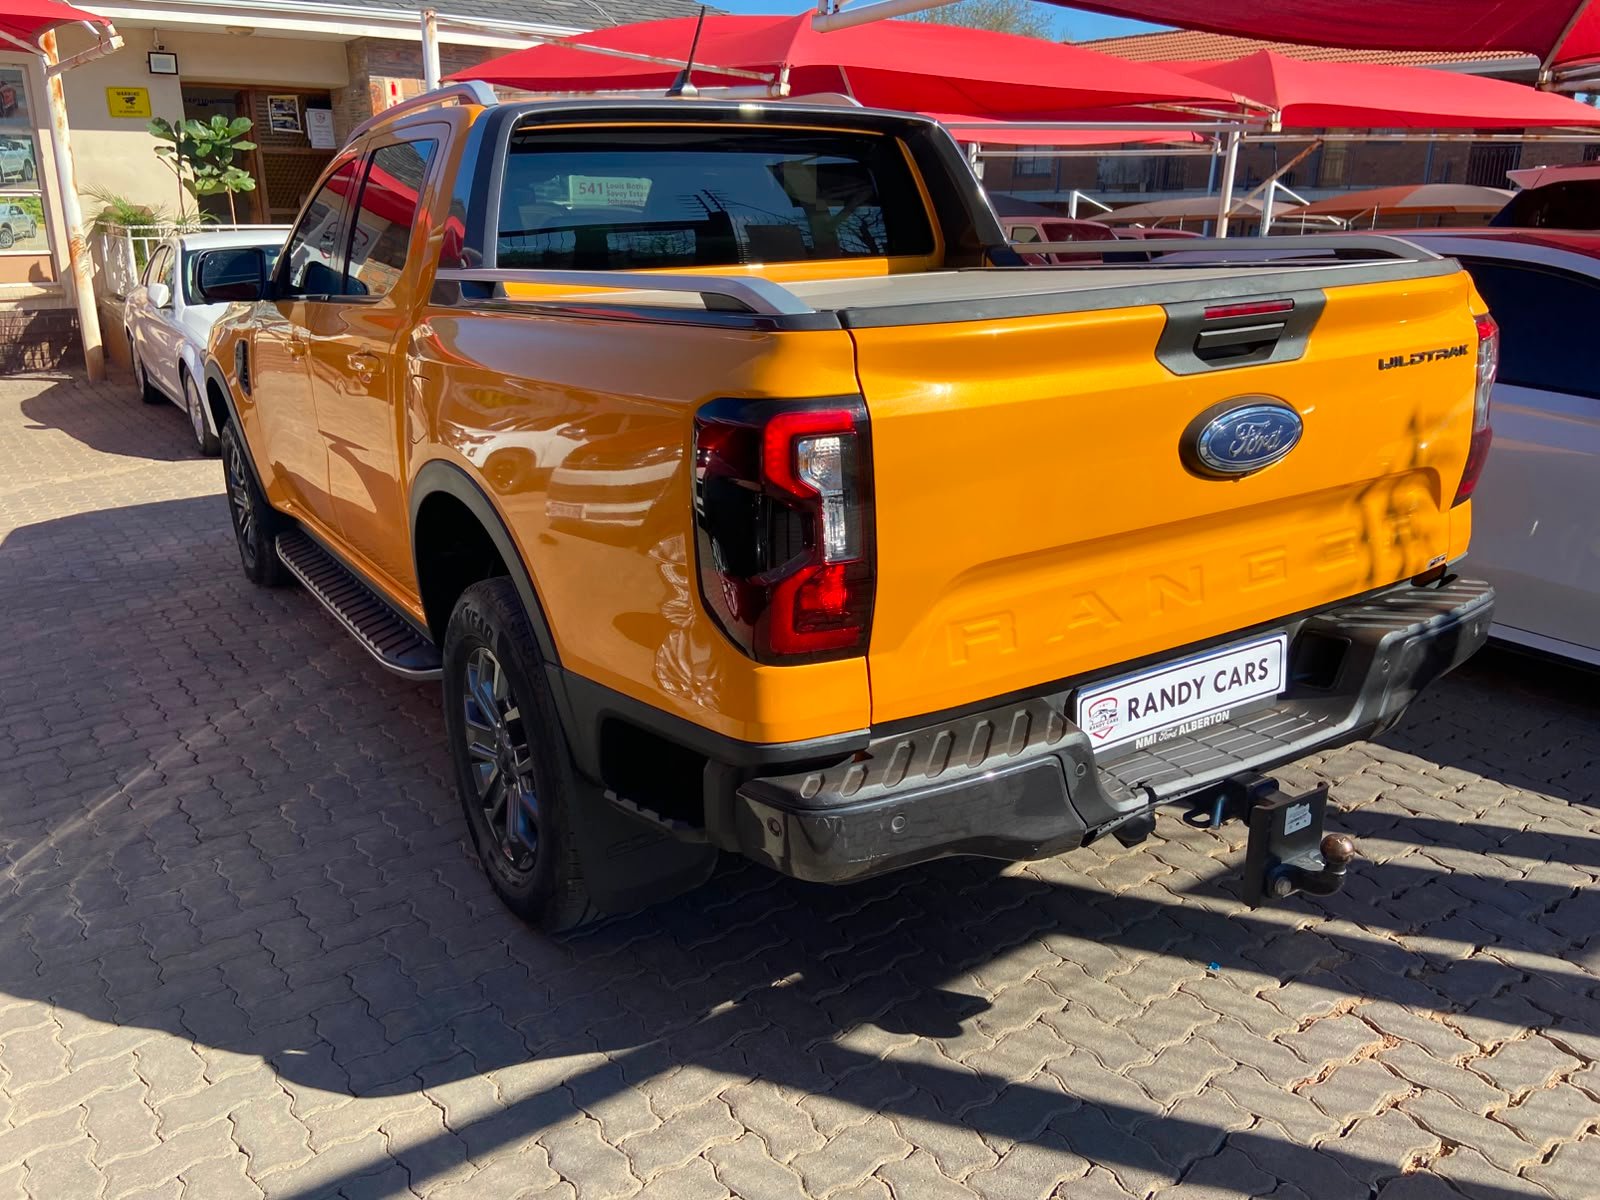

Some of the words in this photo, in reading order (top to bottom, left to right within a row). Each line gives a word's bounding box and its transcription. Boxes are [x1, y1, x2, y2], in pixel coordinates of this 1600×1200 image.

[579, 182, 603, 194] 541
[1378, 343, 1469, 370] WILDTRAK
[1229, 419, 1283, 458] Ford
[1128, 676, 1206, 722] RANDY
[1214, 658, 1268, 693] CARS
[1089, 722, 1105, 730] RANDY
[1136, 736, 1157, 750] NMI
[1159, 730, 1177, 742] Ford
[1178, 710, 1230, 735] ALBERTON
